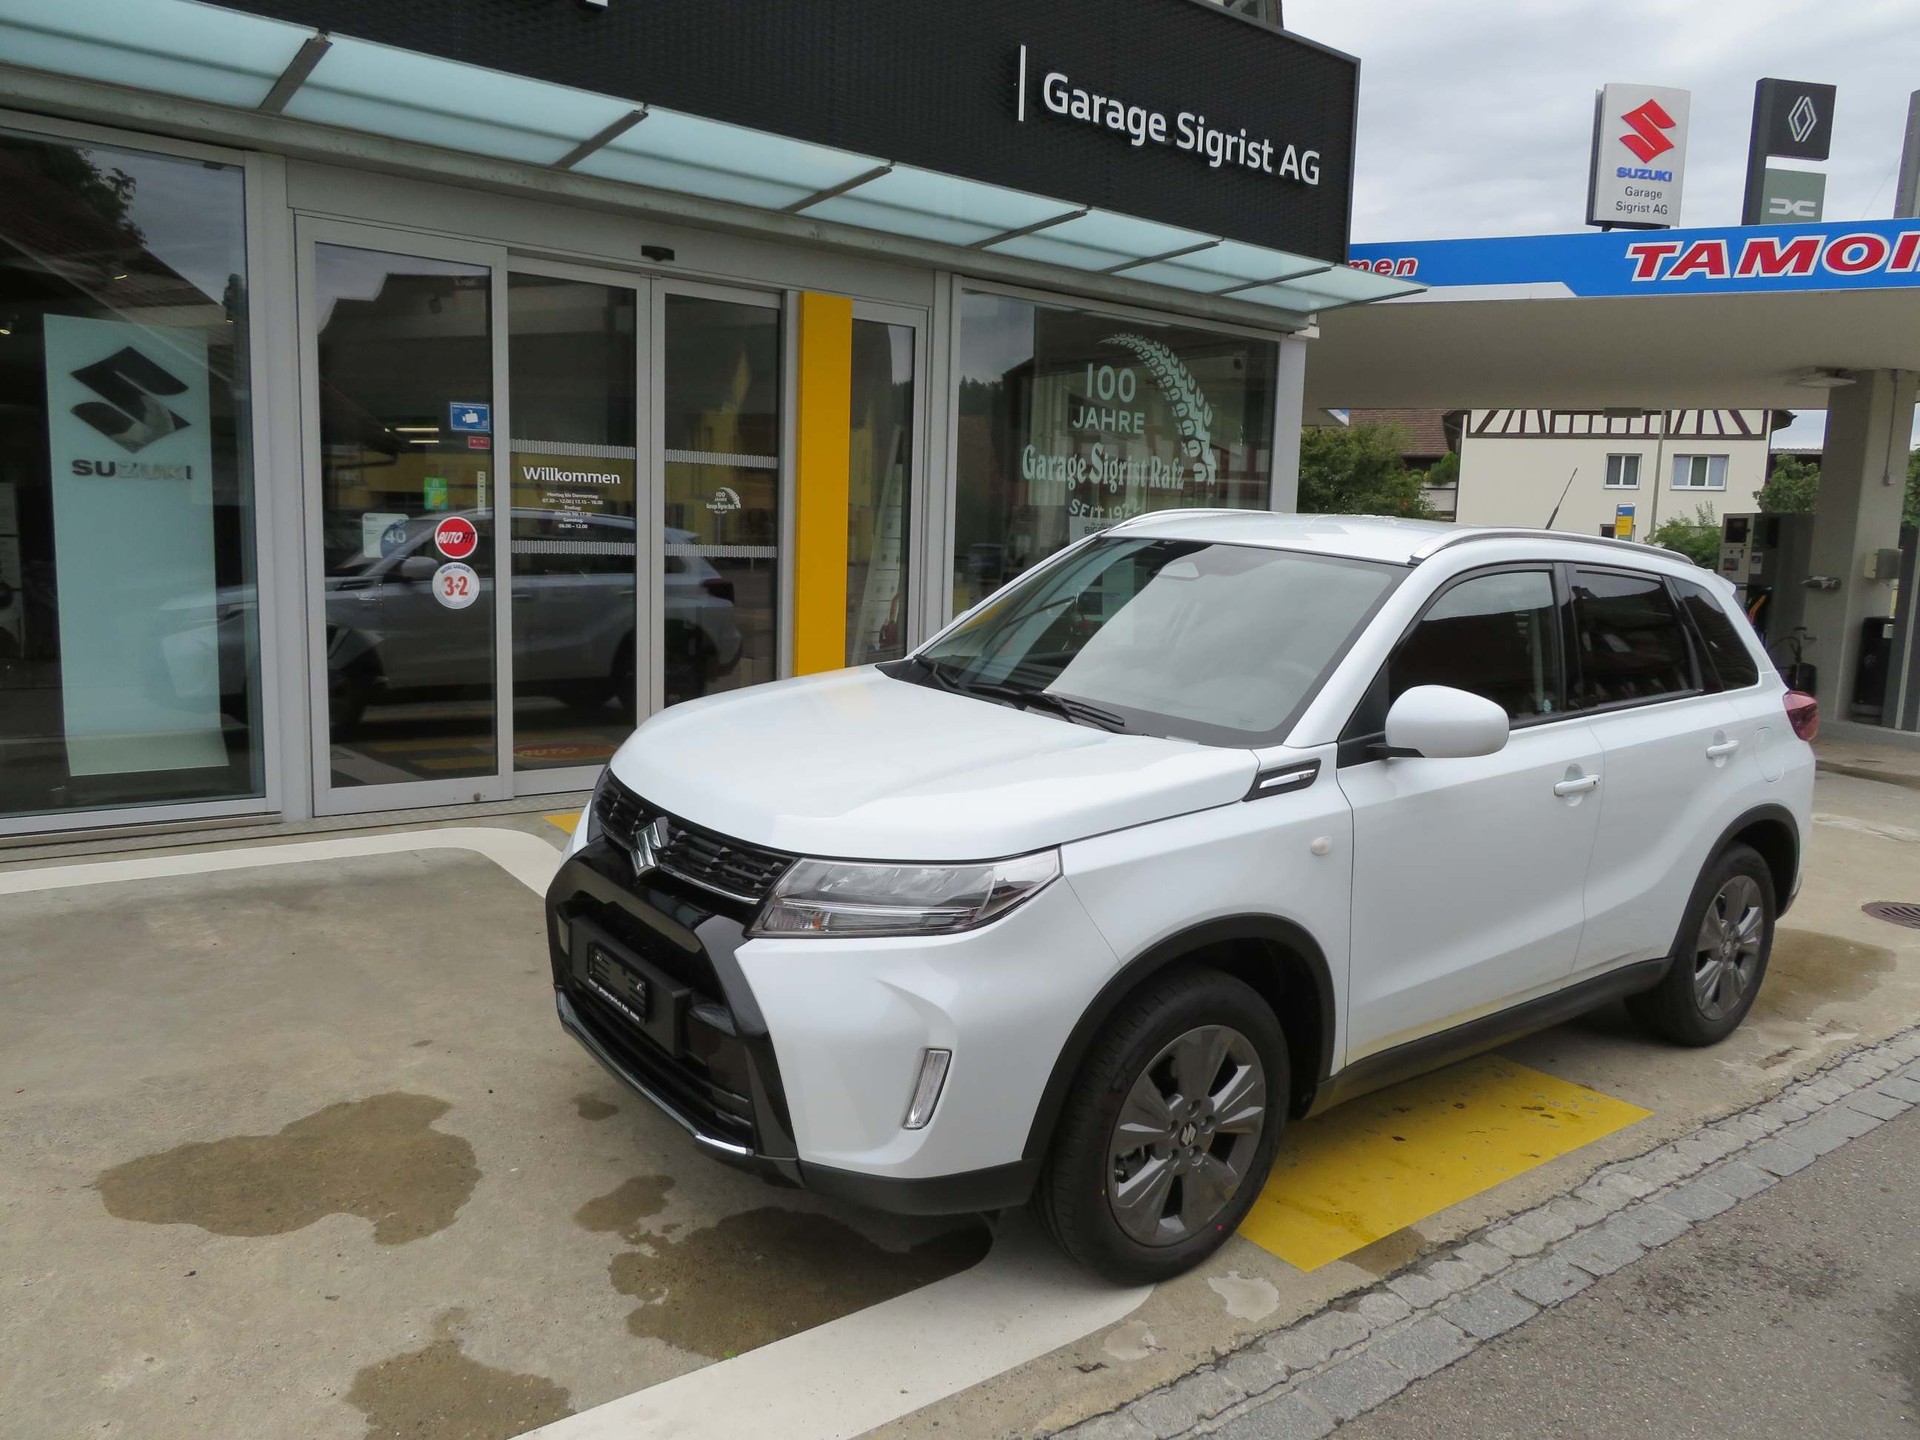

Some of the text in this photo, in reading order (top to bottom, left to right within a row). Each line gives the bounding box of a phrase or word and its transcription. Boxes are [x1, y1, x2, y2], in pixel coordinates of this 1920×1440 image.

[1043, 72, 1321, 186] Garage Sigrist AG
[1616, 166, 1673, 182] SUZUKI
[1624, 185, 1663, 200] Garage
[1615, 200, 1668, 215] Sigrist AG
[1086, 363, 1136, 403] 100
[1072, 405, 1145, 434] JAHRE
[523, 466, 621, 485] Willkommen
[1022, 442, 1185, 493] Garage Sigrist Rafz
[1069, 498, 1104, 521] SEIT
